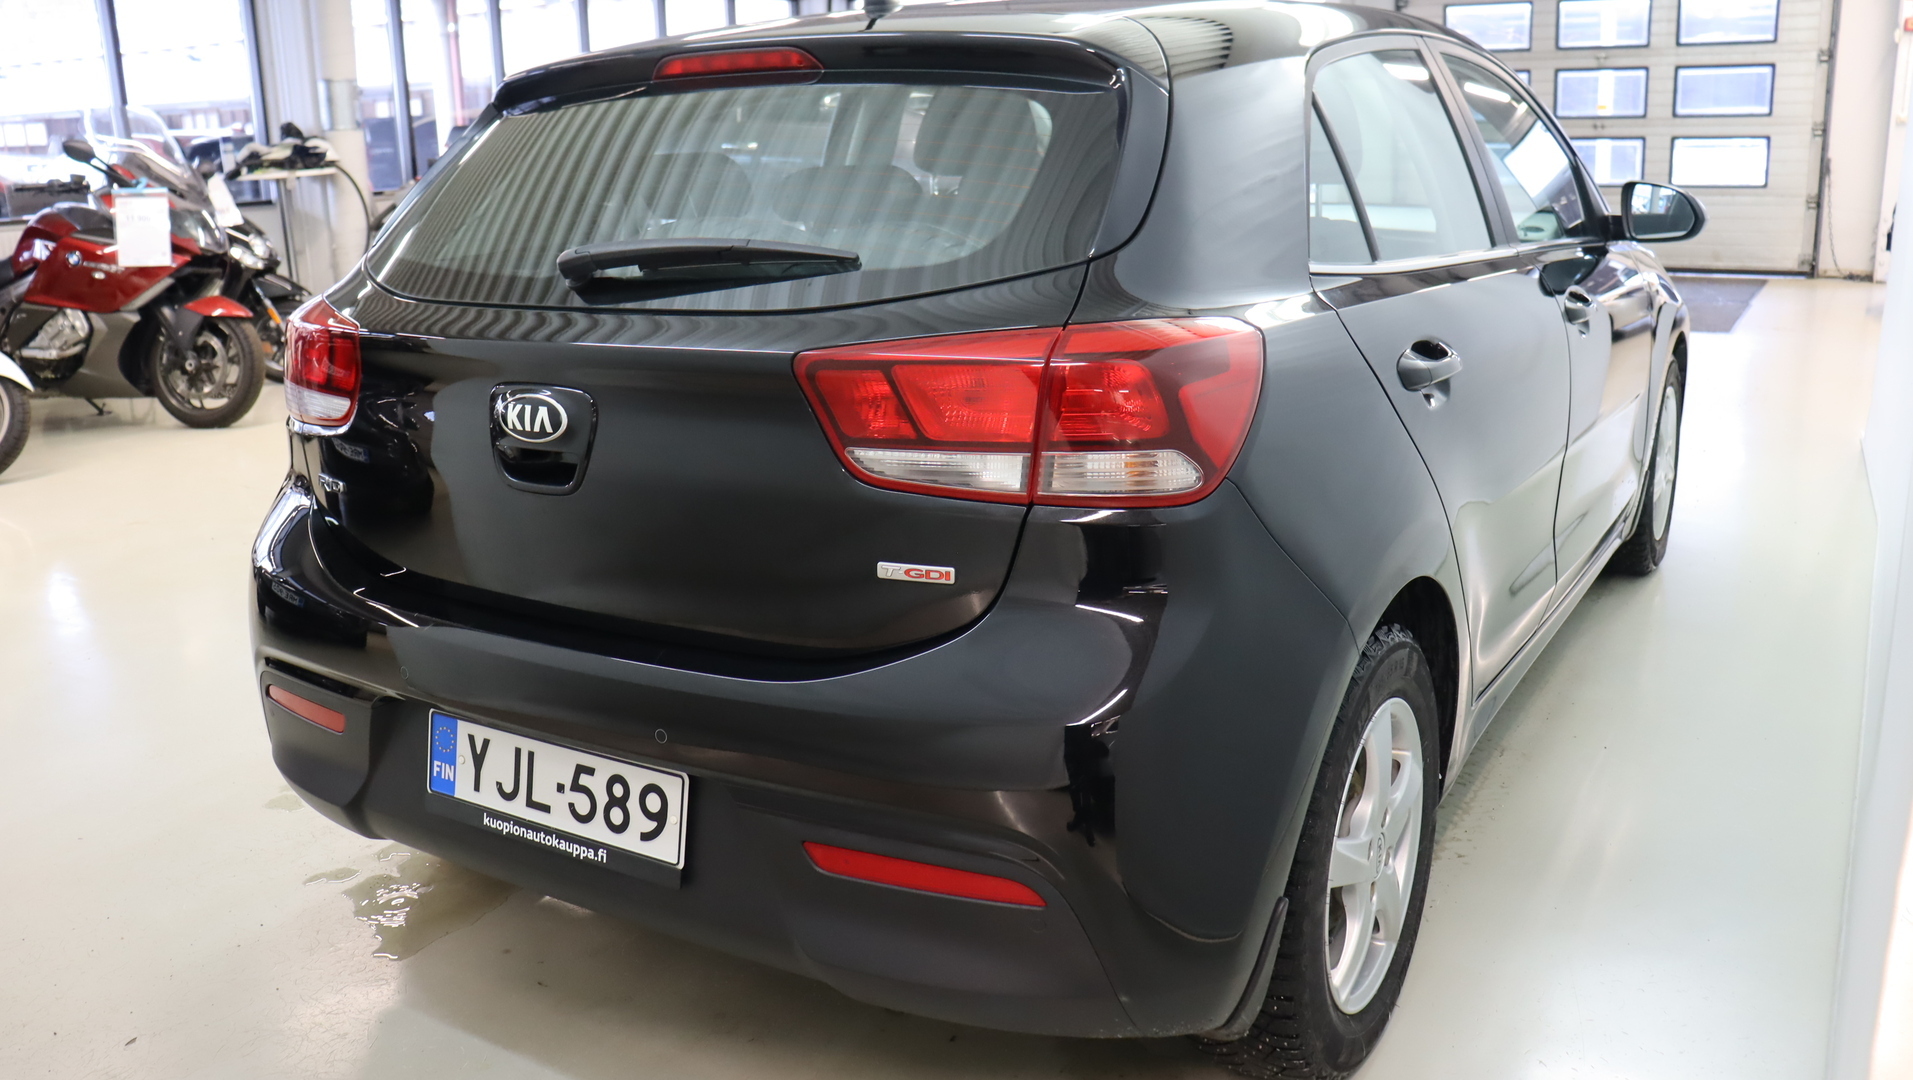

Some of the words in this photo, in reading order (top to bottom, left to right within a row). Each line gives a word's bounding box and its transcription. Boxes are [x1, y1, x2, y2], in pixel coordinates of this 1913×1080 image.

[507, 402, 553, 433] KIA
[433, 760, 455, 782] FIN
[467, 733, 669, 842] YJL-589
[483, 812, 607, 864] kuopionautokauppa.fi
